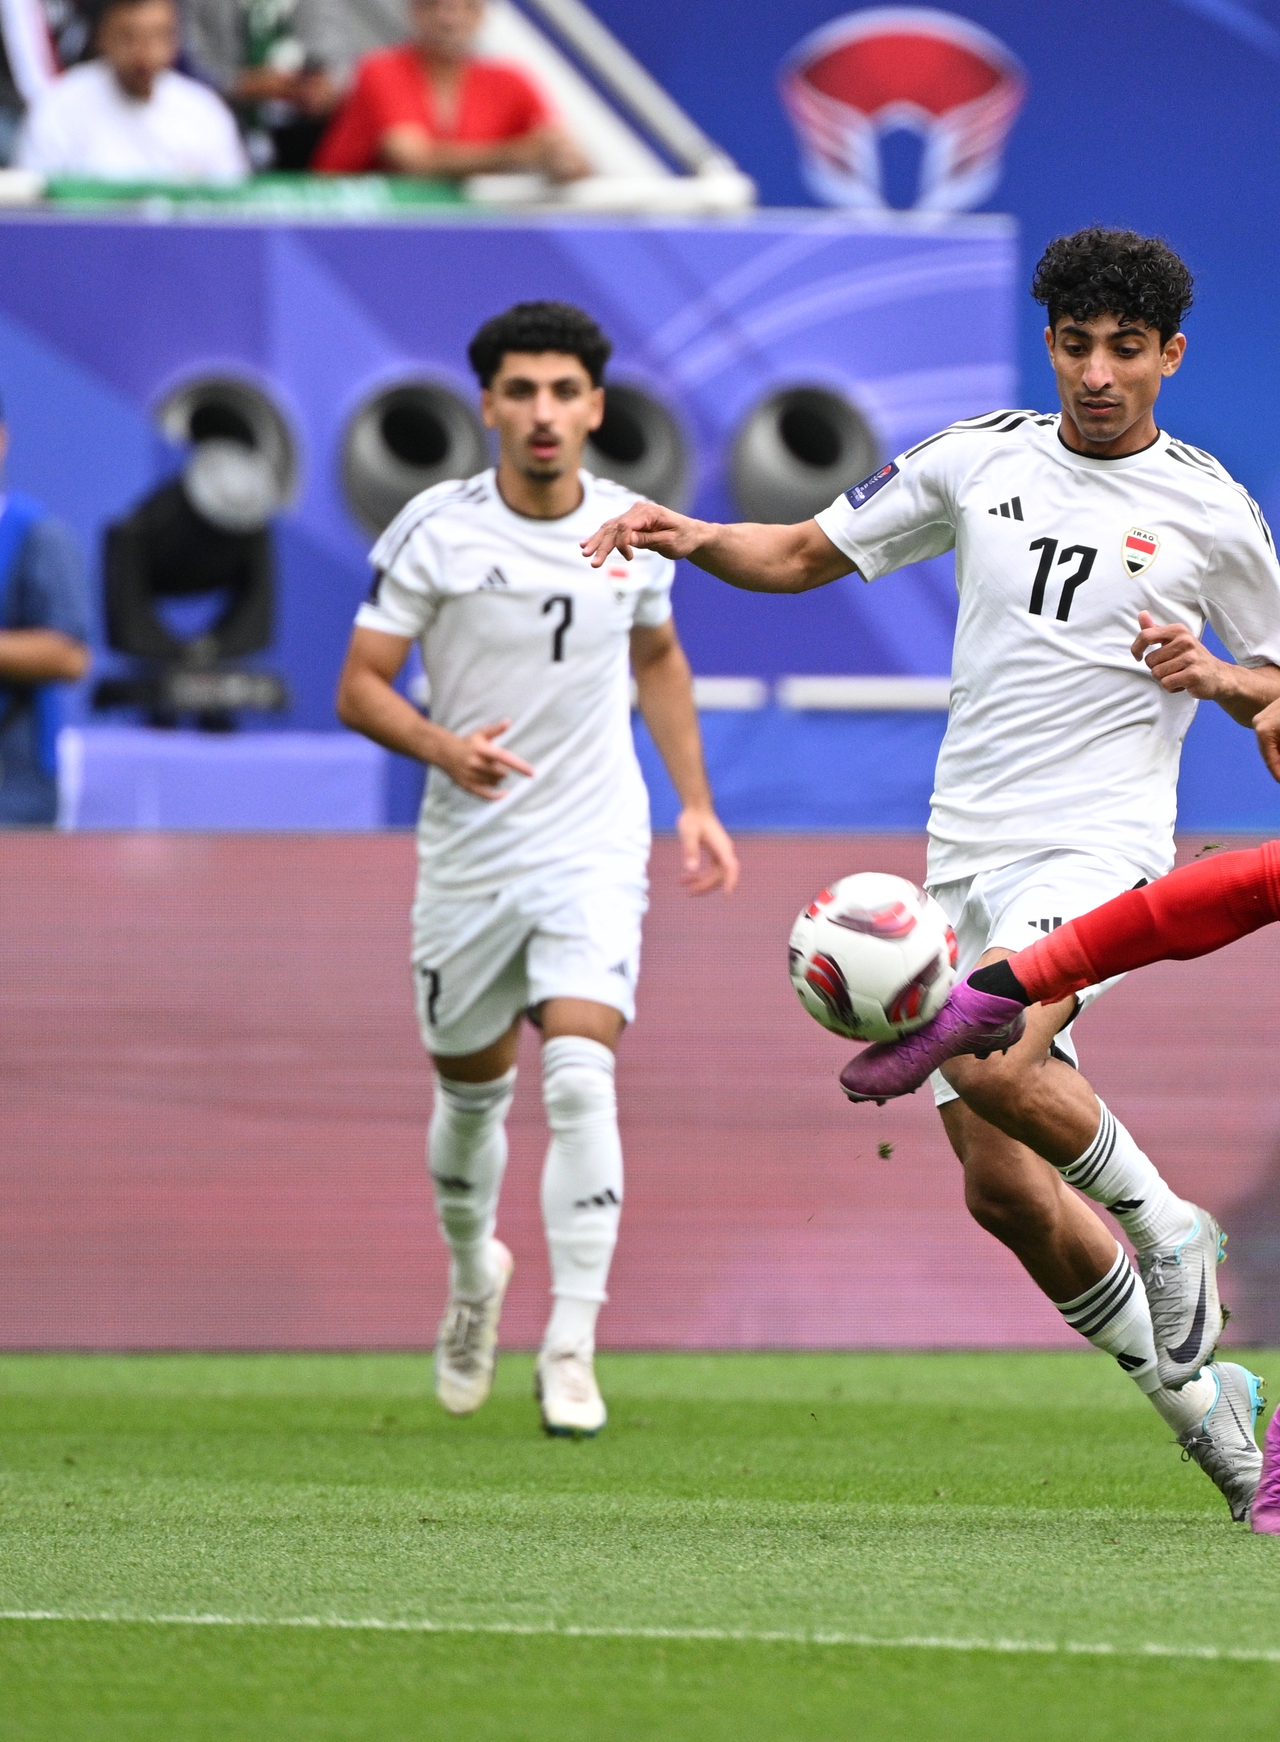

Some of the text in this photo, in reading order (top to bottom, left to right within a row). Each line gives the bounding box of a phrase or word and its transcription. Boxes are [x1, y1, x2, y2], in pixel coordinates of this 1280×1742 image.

[1133, 530, 1155, 542] IRAQ
[1028, 536, 1098, 622] 17
[541, 594, 573, 663] 7
[421, 967, 441, 1026] 7
